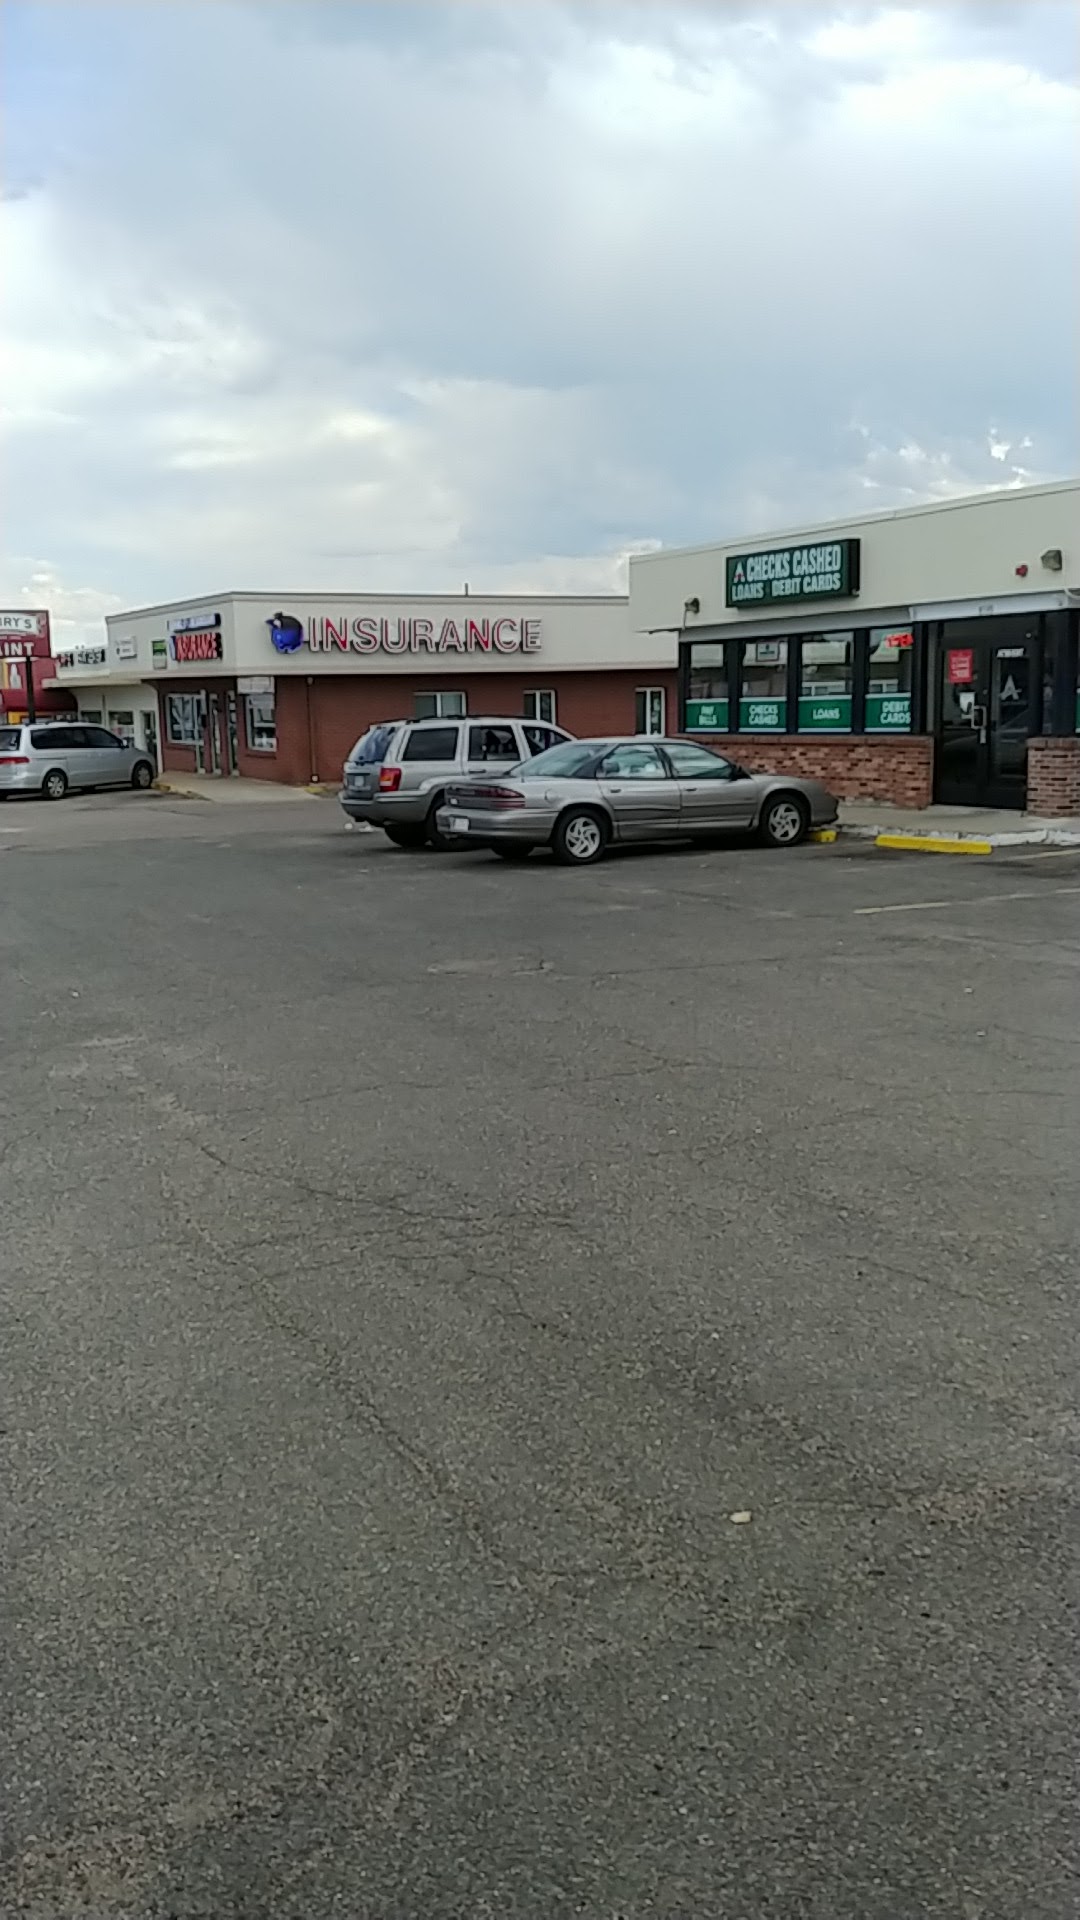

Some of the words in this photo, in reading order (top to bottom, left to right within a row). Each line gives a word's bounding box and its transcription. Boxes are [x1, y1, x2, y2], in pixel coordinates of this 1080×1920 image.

[746, 551, 790, 582] CHECKS
[792, 545, 841, 576] CASHED
[732, 582, 765, 601] LOANS
[771, 577, 802, 597] DEBIT
[803, 573, 841, 593] CARDS
[0, 642, 34, 656] INT
[307, 616, 543, 653] INSURANCE
